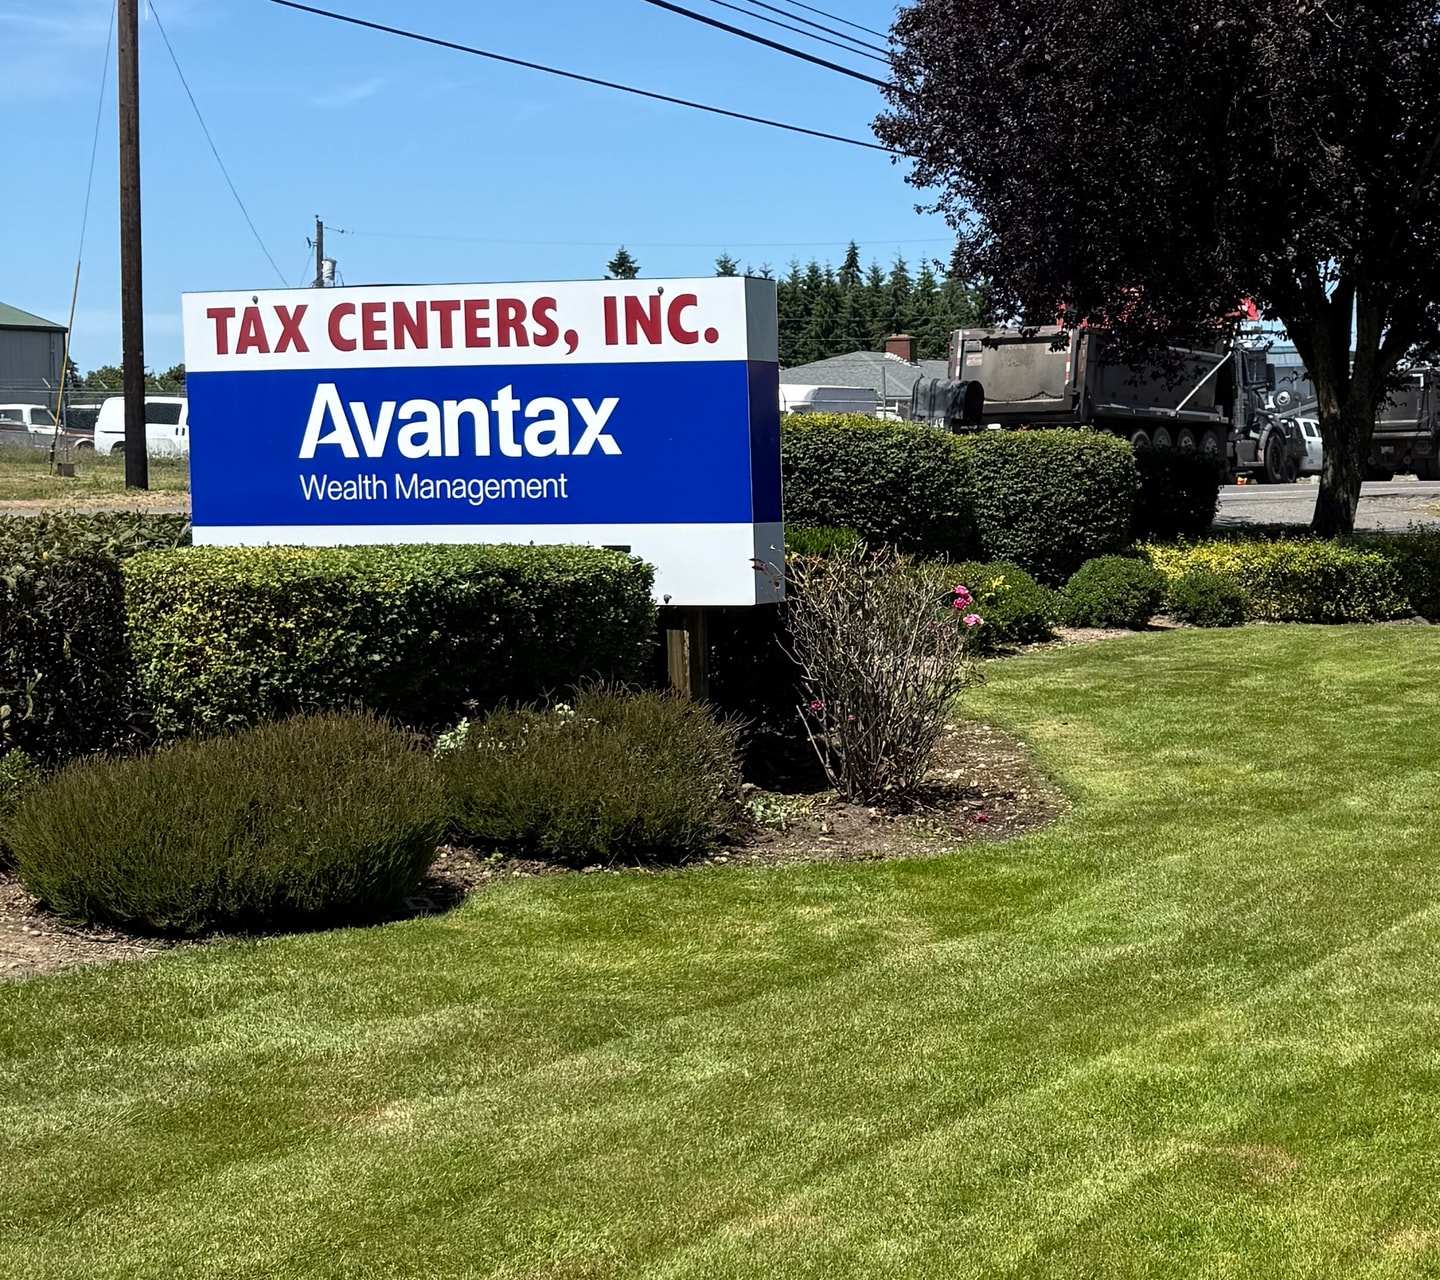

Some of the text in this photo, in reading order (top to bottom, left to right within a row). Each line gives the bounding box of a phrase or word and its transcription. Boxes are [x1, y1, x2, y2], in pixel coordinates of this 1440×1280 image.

[206, 293, 719, 356] TAX CENTERS, INC.
[297, 382, 623, 460] Avantax
[299, 472, 569, 506] Wealth Management
